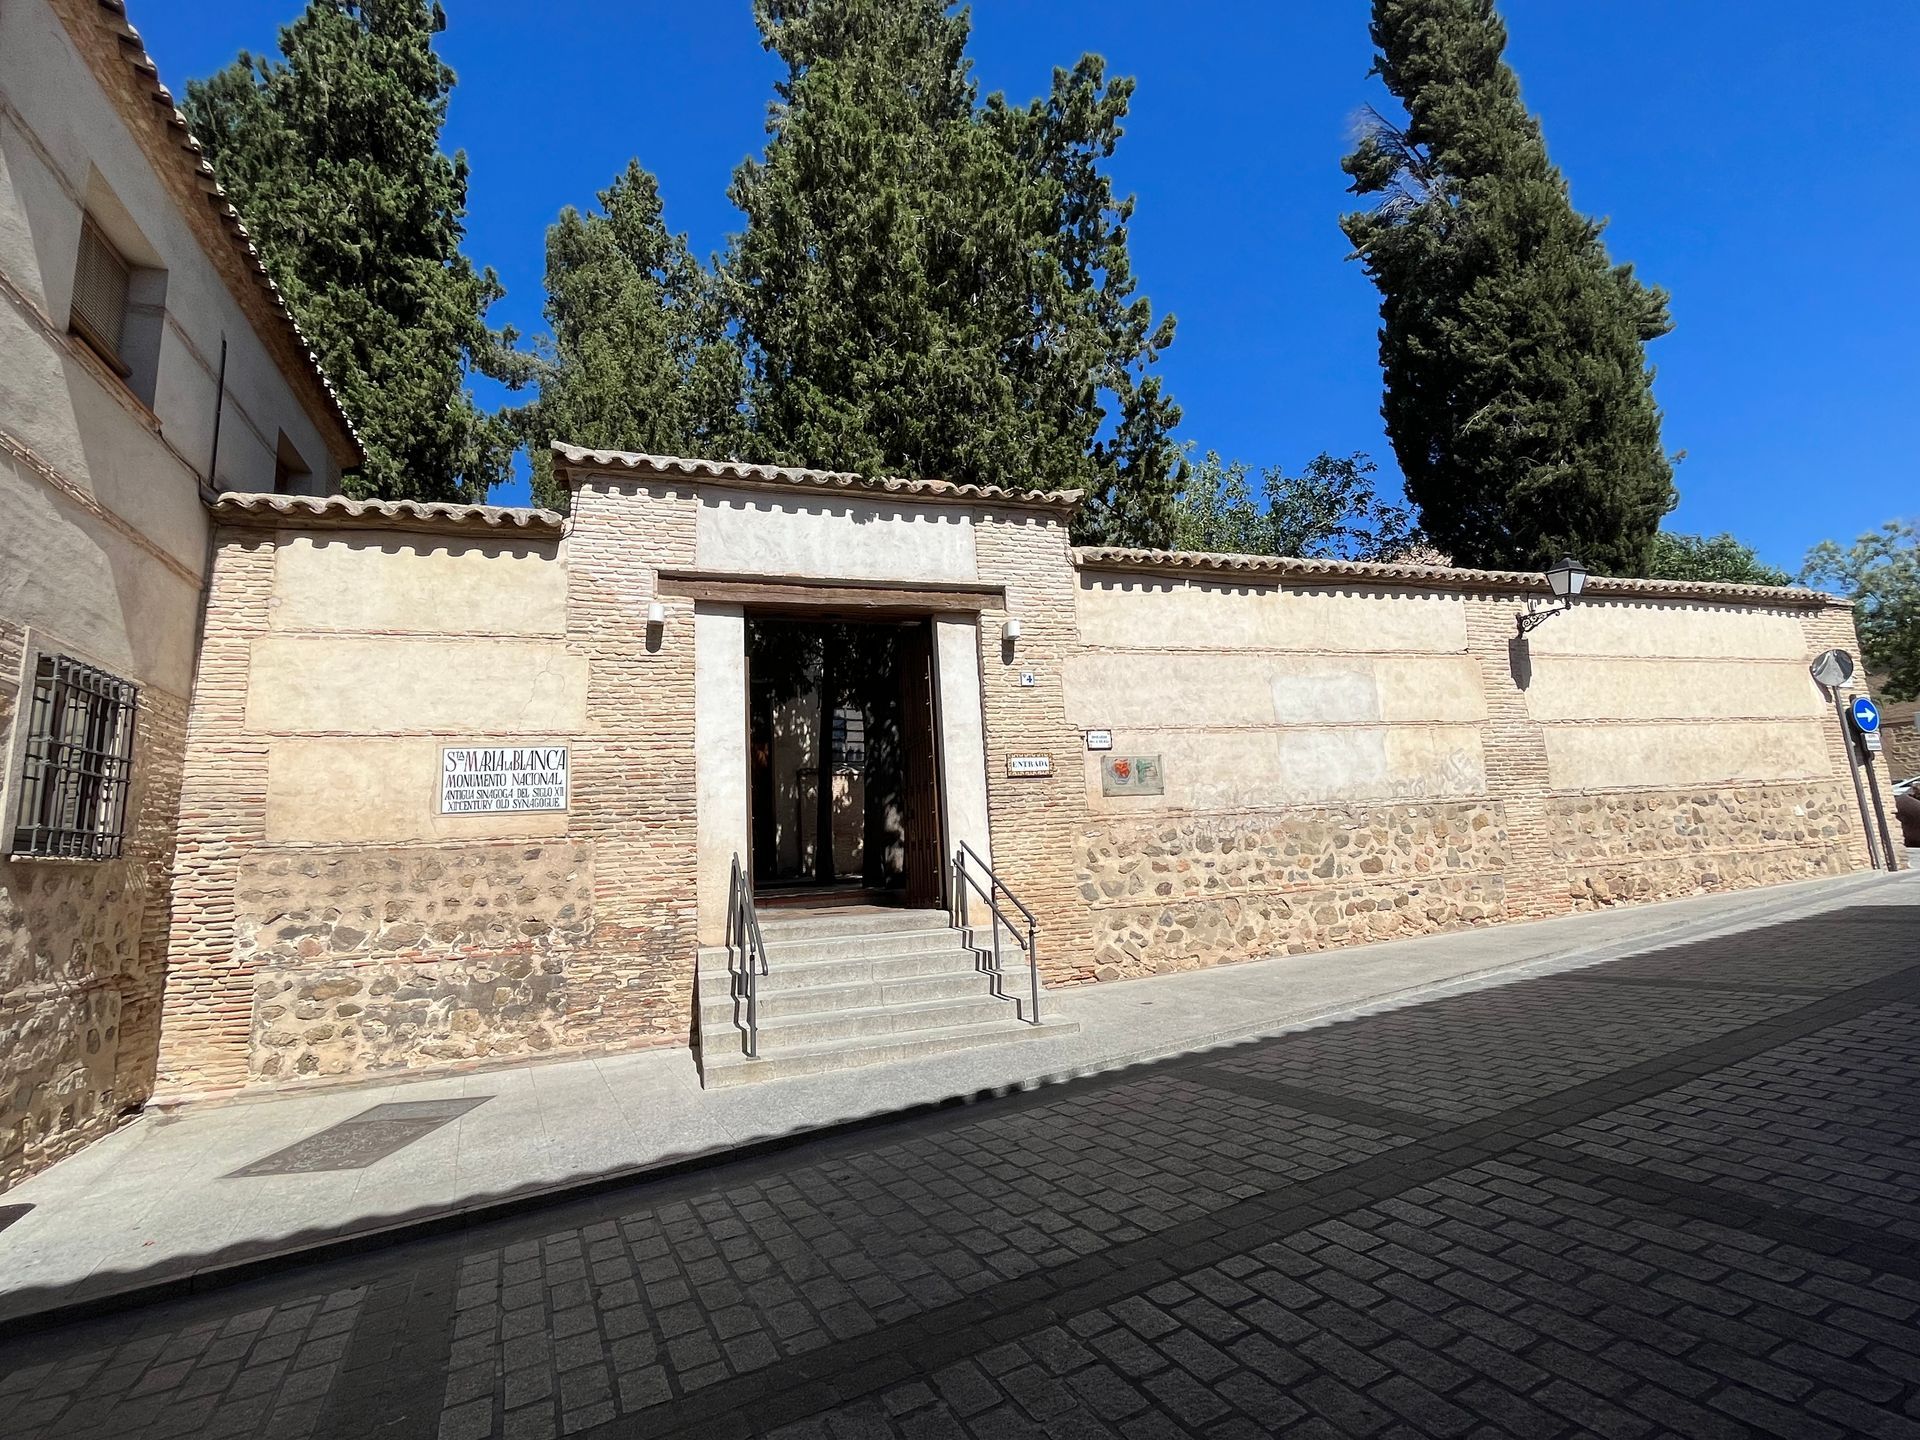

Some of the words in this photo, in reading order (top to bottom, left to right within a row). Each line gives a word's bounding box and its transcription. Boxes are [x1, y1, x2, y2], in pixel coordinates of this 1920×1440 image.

[464, 750, 504, 772] MARIA
[505, 760, 513, 771] LA
[513, 749, 565, 771] BLANCA
[1012, 760, 1048, 768] ENTRADA
[445, 773, 507, 788] MONUMENTO
[512, 772, 563, 786] NACIONAL
[444, 789, 475, 801] ANTIGUA
[476, 788, 514, 800] SINAGOGA
[517, 788, 530, 799] DEL
[532, 786, 553, 798] SIGLO
[554, 786, 564, 797] XII
[495, 799, 510, 809] OLD
[512, 797, 560, 809] SYNAGOGUE
